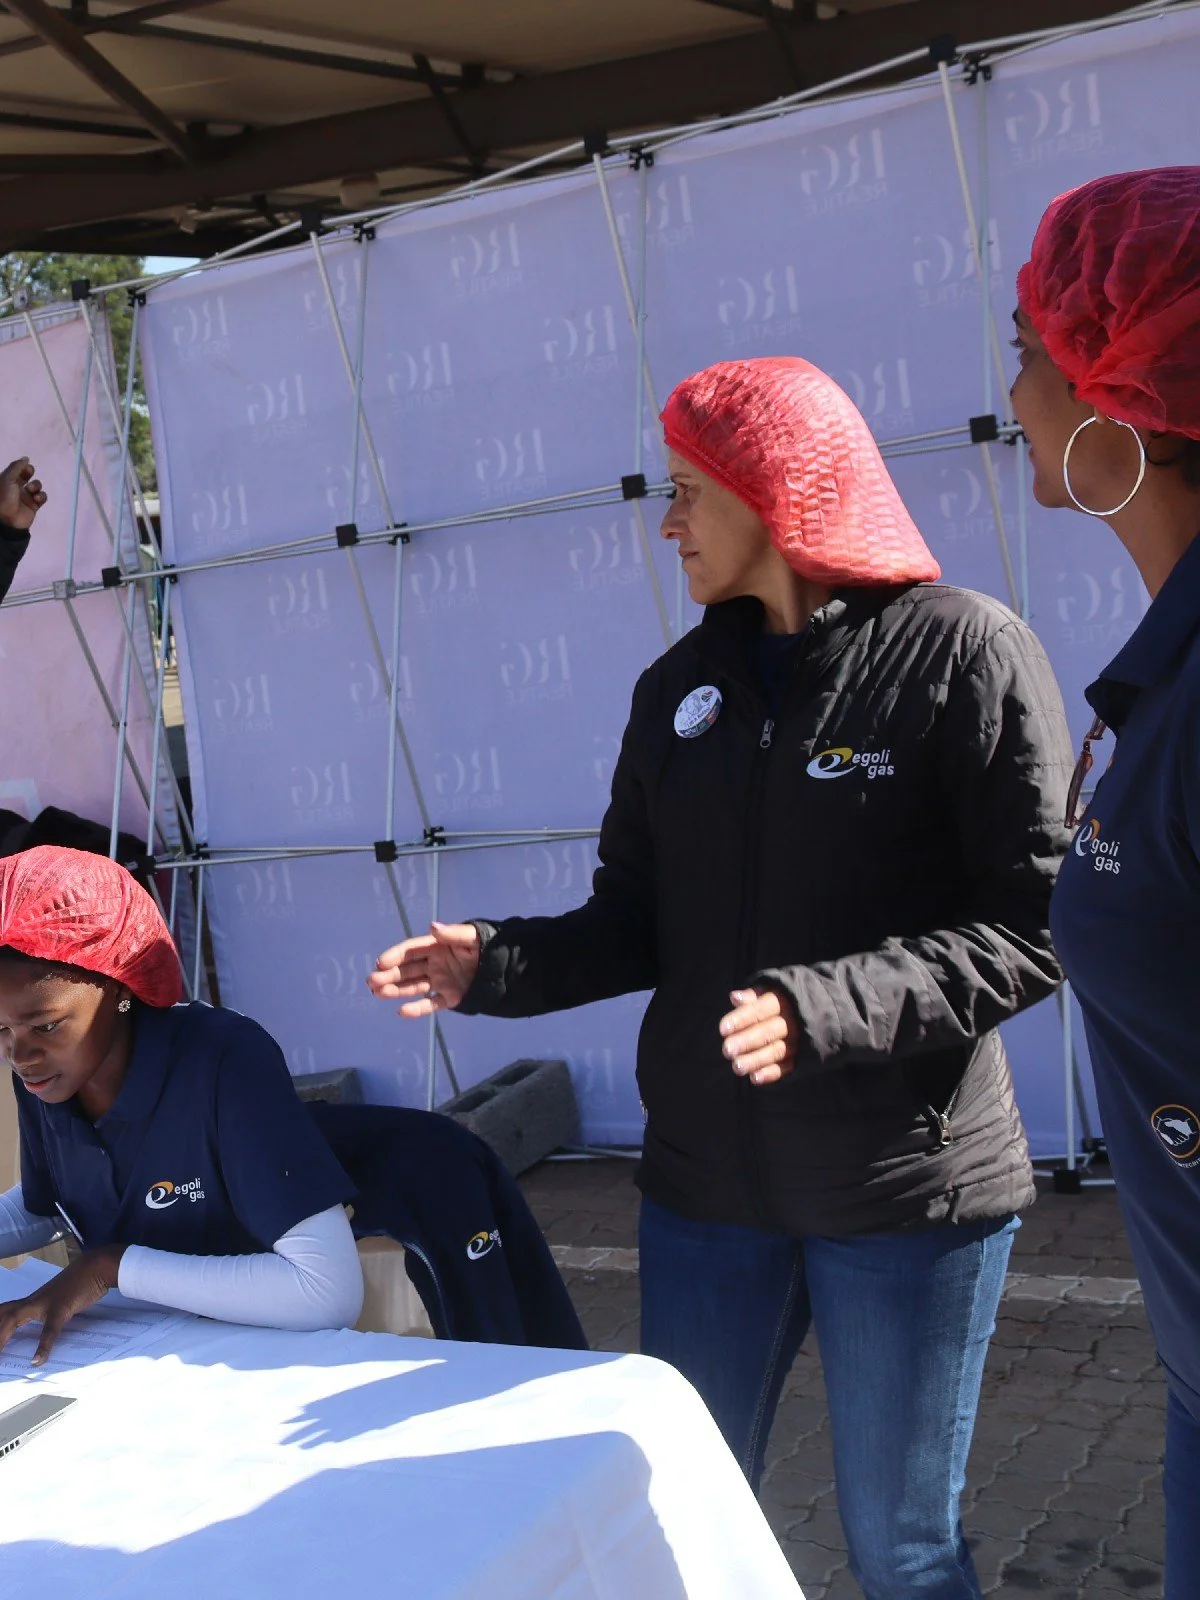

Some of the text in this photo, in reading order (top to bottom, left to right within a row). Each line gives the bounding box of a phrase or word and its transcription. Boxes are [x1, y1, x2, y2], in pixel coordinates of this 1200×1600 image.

[852, 749, 891, 767] egoli
[867, 765, 895, 779] gas
[1094, 856, 1121, 875] gas
[174, 1178, 201, 1195] egoli
[189, 1190, 205, 1203] gas
